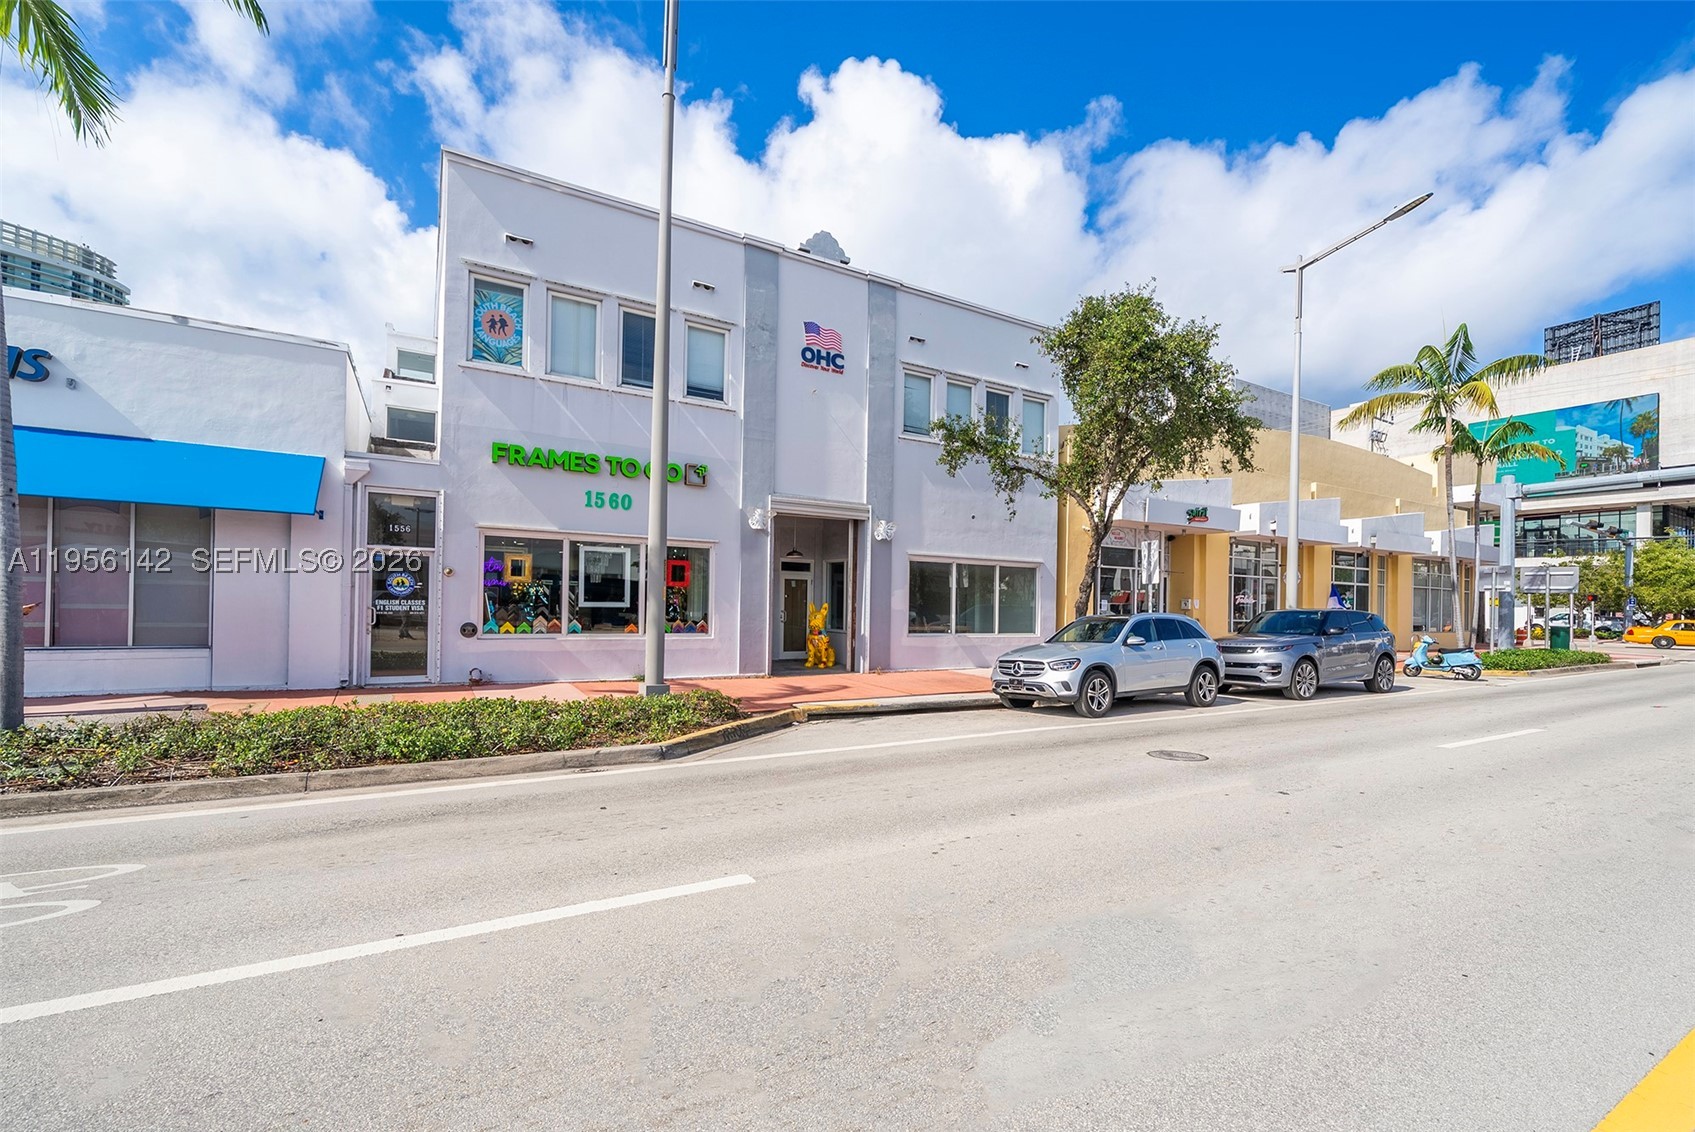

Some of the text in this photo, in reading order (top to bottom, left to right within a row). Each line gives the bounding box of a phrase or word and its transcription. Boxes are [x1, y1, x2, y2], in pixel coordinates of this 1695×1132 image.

[475, 302, 522, 330] SOUTH BEACH
[475, 327, 520, 347] LANGUAGES
[801, 346, 845, 370] OHC
[491, 441, 600, 474] FRAMES
[605, 456, 642, 479] TO
[584, 490, 632, 511] 1560
[389, 524, 411, 533] 1556
